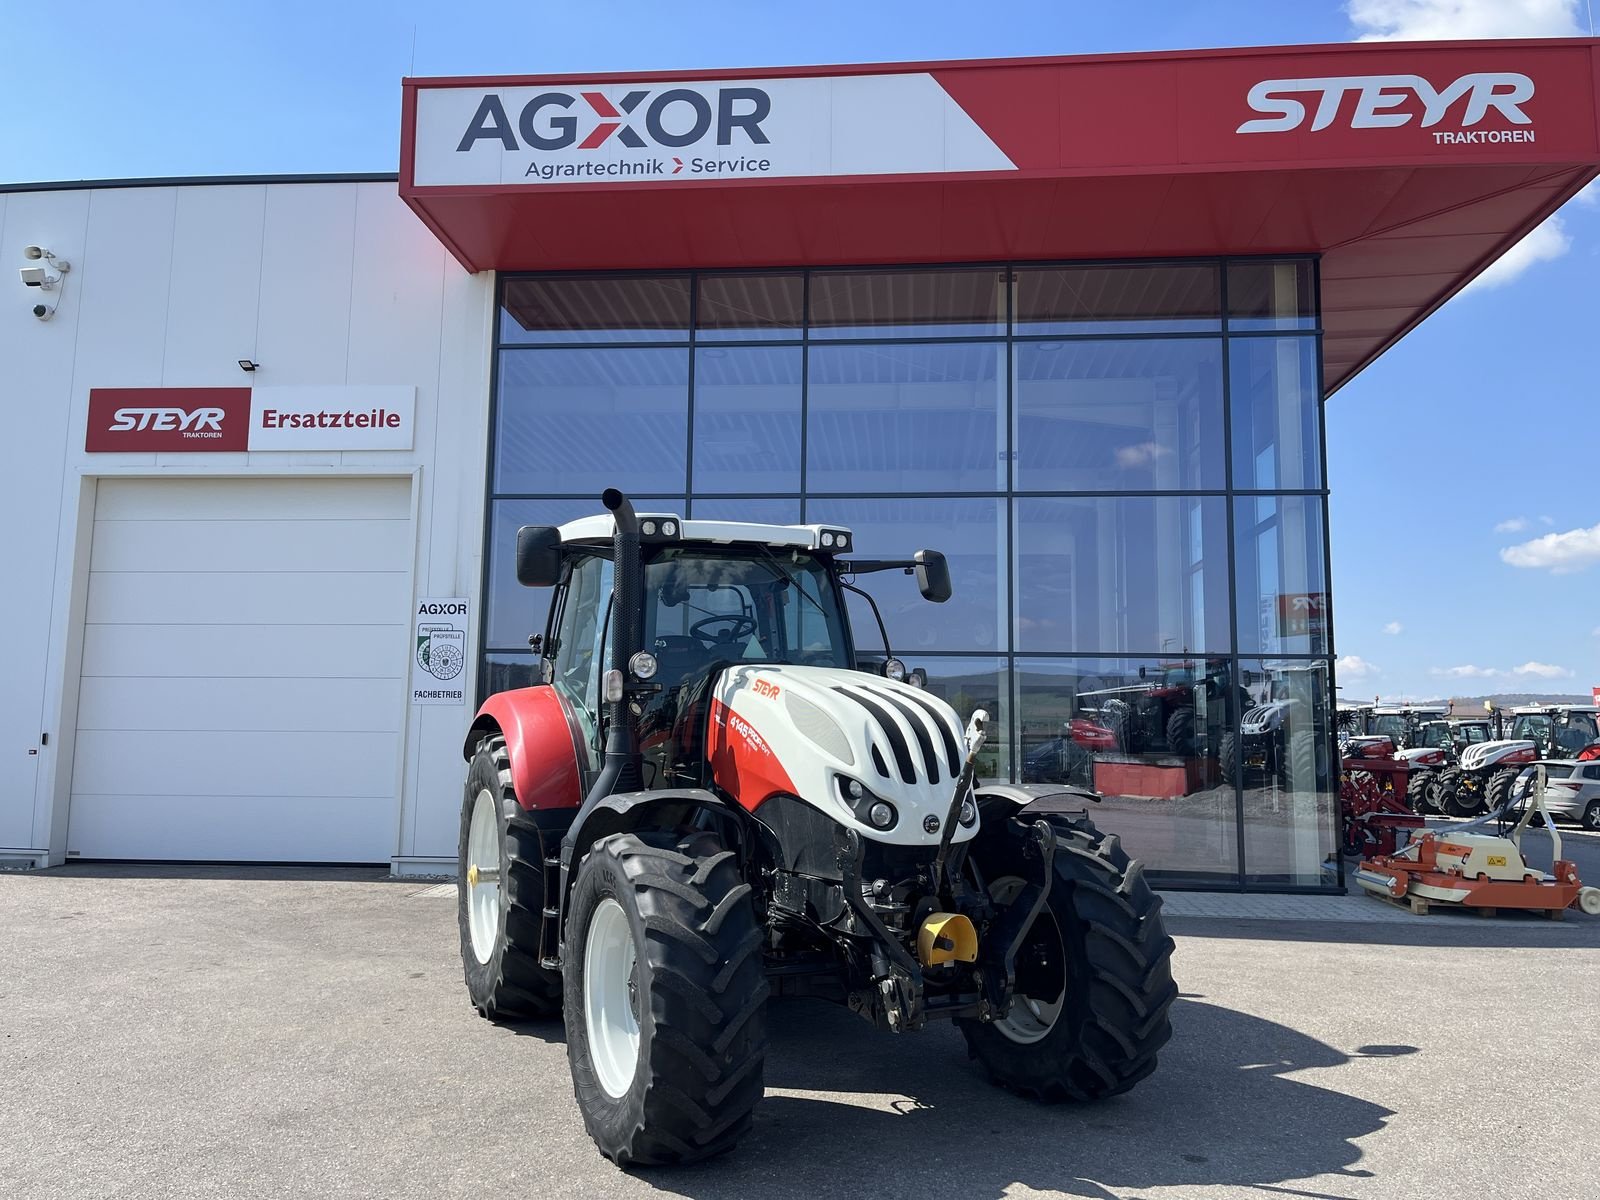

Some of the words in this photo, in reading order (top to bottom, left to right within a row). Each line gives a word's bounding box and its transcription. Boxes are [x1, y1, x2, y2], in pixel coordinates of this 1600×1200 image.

[1236, 72, 1535, 134] STEYR
[455, 87, 771, 152] AGXOR
[1432, 130, 1535, 144] TRAKTOREN
[524, 157, 664, 179] Agrartechnik
[690, 157, 771, 173] Service
[109, 408, 225, 431] STEYR
[262, 409, 401, 429] Ersatzteile
[182, 431, 223, 439] TRAKTOREN
[419, 604, 466, 614] AGXOR
[752, 679, 780, 700] STEYR
[730, 716, 748, 738] 4145
